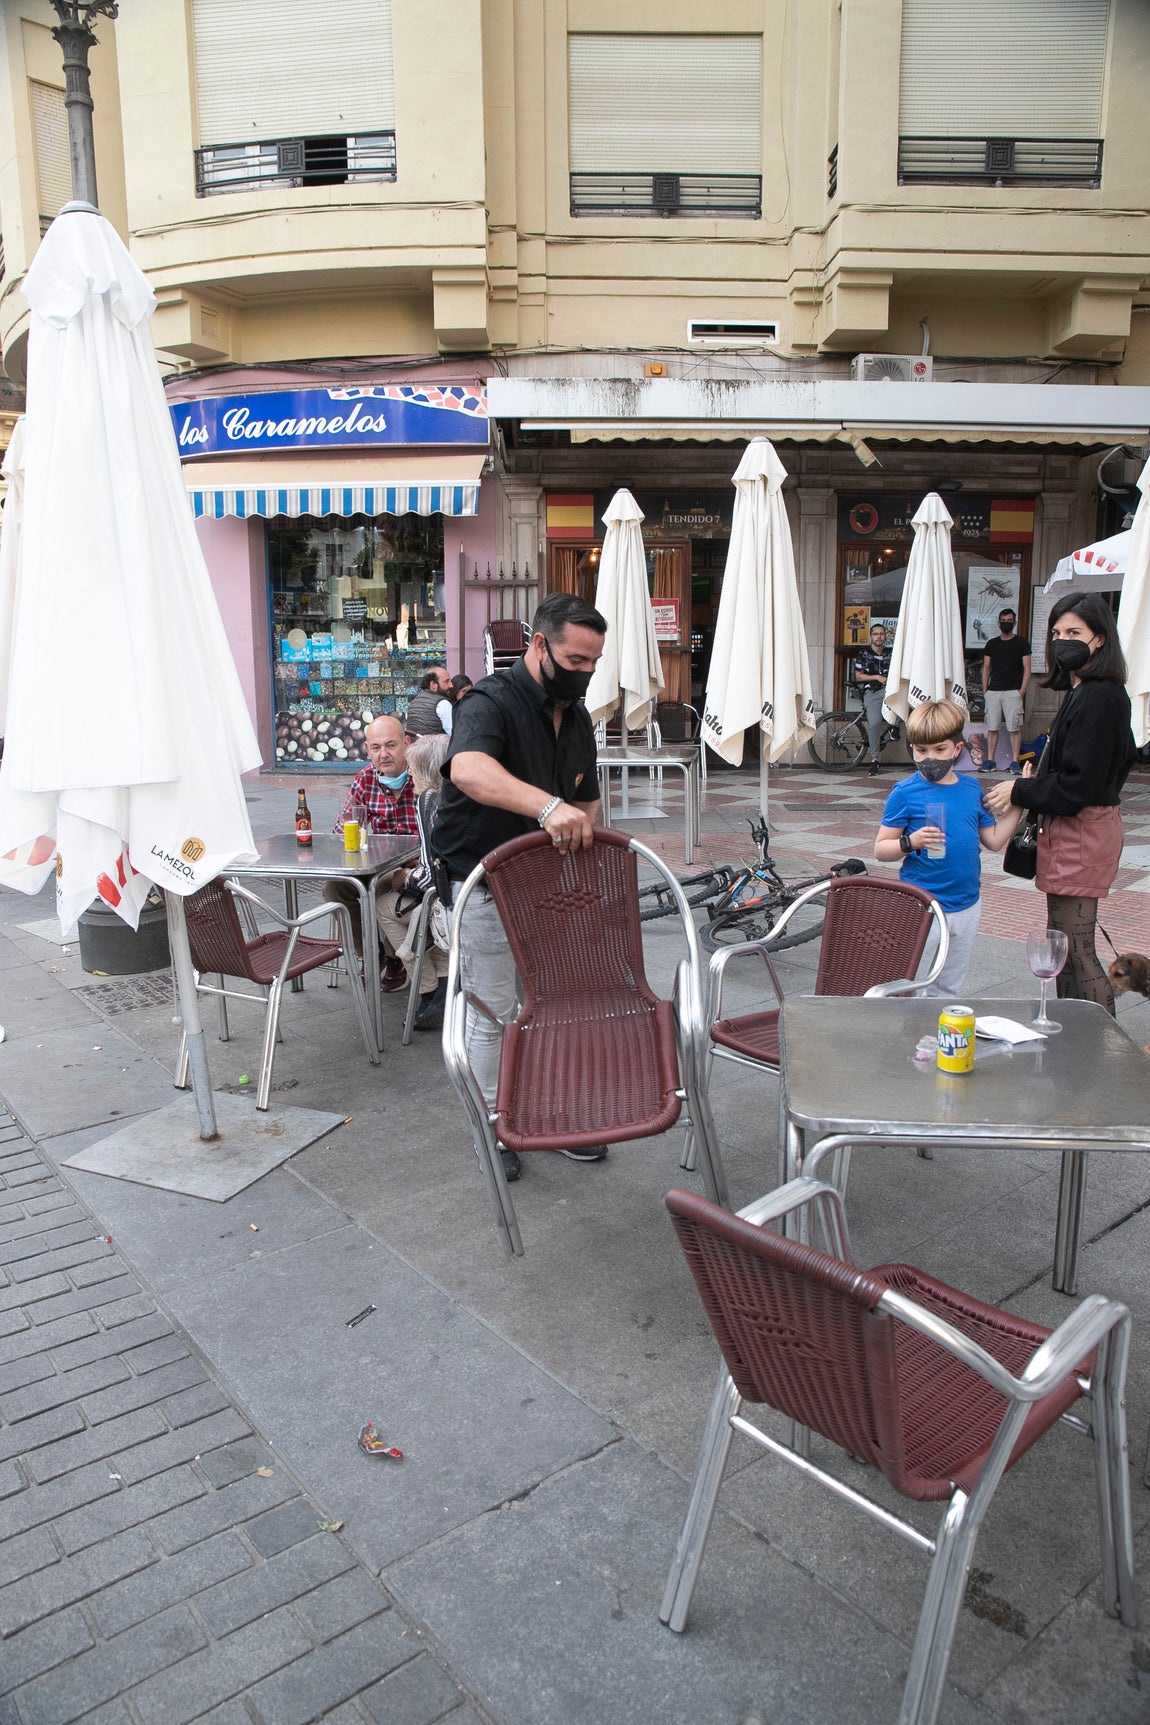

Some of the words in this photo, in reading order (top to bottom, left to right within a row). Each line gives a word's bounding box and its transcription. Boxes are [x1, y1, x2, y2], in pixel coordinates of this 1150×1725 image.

[179, 416, 209, 446] los
[222, 403, 387, 440] Caramelos
[668, 514, 714, 524] TENDIDO
[714, 515, 721, 524] 7
[894, 518, 904, 526] EL
